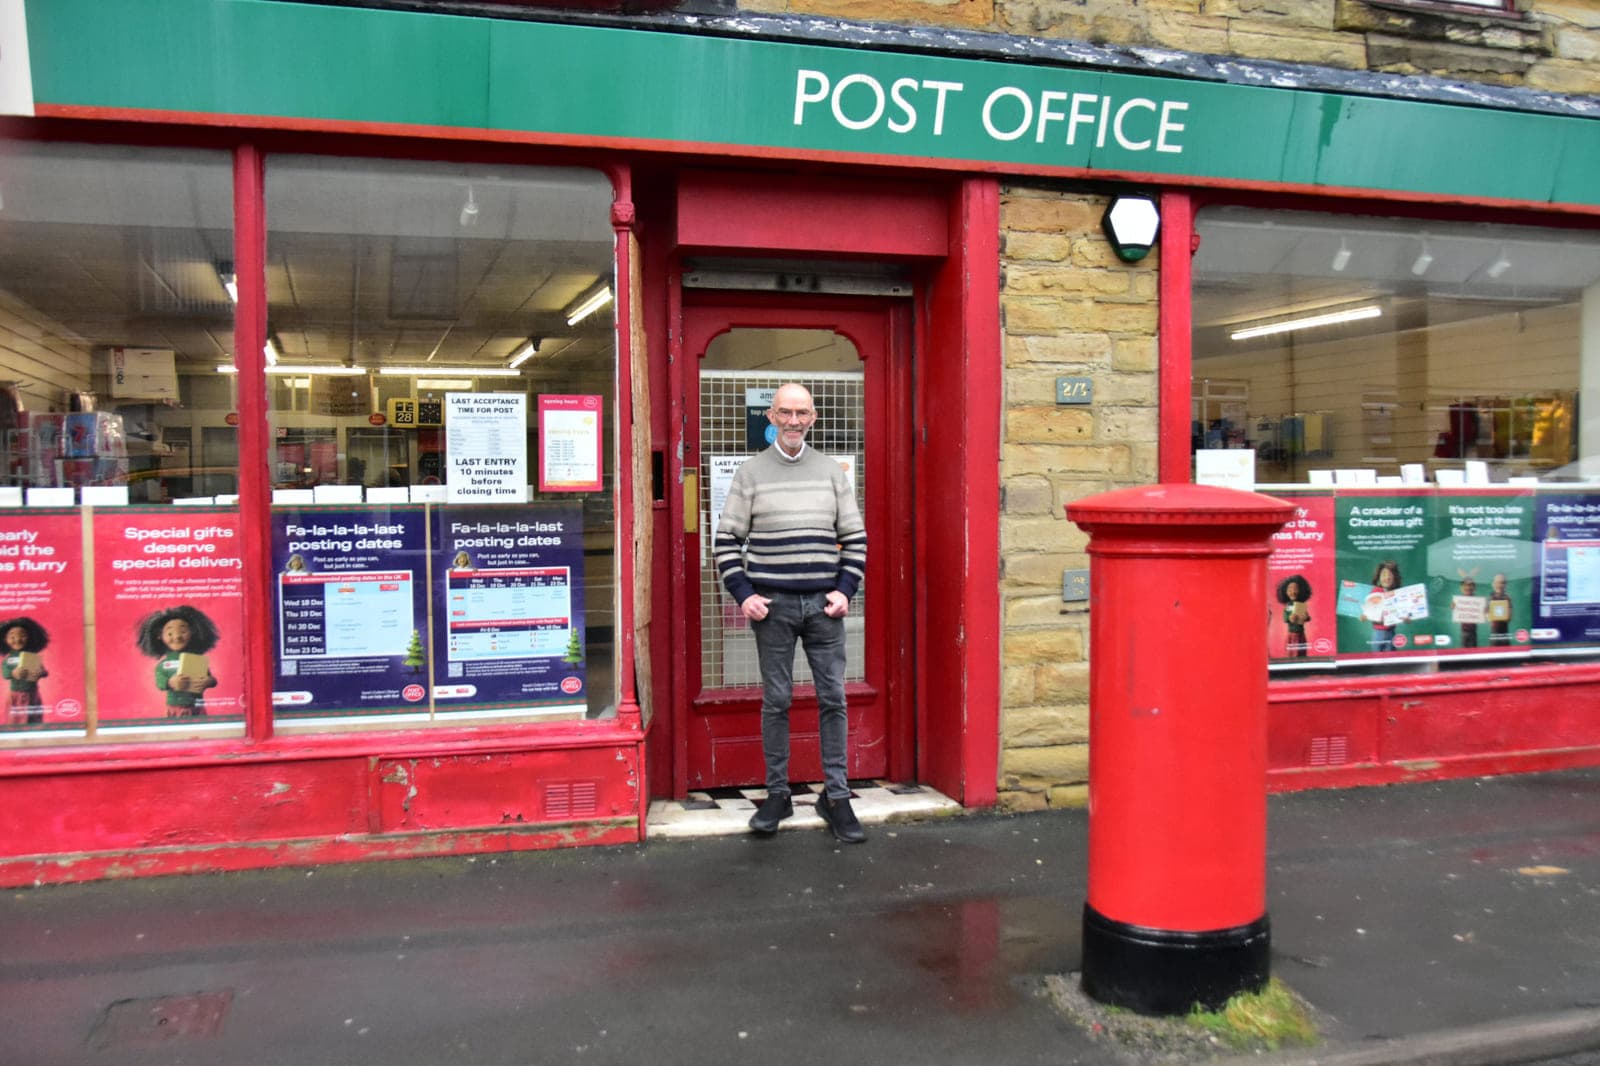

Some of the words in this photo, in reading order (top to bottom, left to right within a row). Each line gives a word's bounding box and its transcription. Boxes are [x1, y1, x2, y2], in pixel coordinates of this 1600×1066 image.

[793, 69, 964, 136] POST
[982, 86, 1189, 154] OFFICE
[760, 392, 775, 400] am
[397, 412, 412, 422] 28
[455, 458, 481, 466] LAST
[484, 458, 517, 466] ENTRY
[461, 468, 472, 476] 10
[475, 468, 514, 476] minutes
[457, 488, 492, 496] closing
[495, 487, 517, 495] time
[1350, 506, 1361, 515] A
[1361, 506, 1403, 515] cracker
[1403, 505, 1415, 515] of
[1415, 507, 1423, 515] a
[1465, 506, 1485, 514] not
[1485, 506, 1505, 514] too
[1505, 505, 1524, 514] late
[1297, 519, 1317, 528] the
[1349, 517, 1405, 527] Christmas
[1405, 517, 1424, 528] gift
[1452, 517, 1464, 525] to
[1465, 517, 1484, 527] get
[1485, 516, 1493, 525] it
[1494, 516, 1521, 525] there
[1547, 516, 1585, 525] posting
[286, 523, 405, 536] Fa-la-la-la-last
[451, 521, 564, 534] Fa-la-la-la-last
[1452, 527, 1467, 536] for
[1468, 527, 1521, 537] Christmas
[125, 526, 190, 541] Special
[193, 526, 235, 541] gifts
[1294, 530, 1325, 541] flurry
[143, 541, 216, 553] deserve
[289, 539, 352, 553] posting
[355, 538, 403, 550] dates
[454, 536, 514, 550] posting
[517, 536, 561, 547] dates
[23, 544, 56, 556] the
[19, 559, 68, 573] flurry
[112, 556, 175, 571] special
